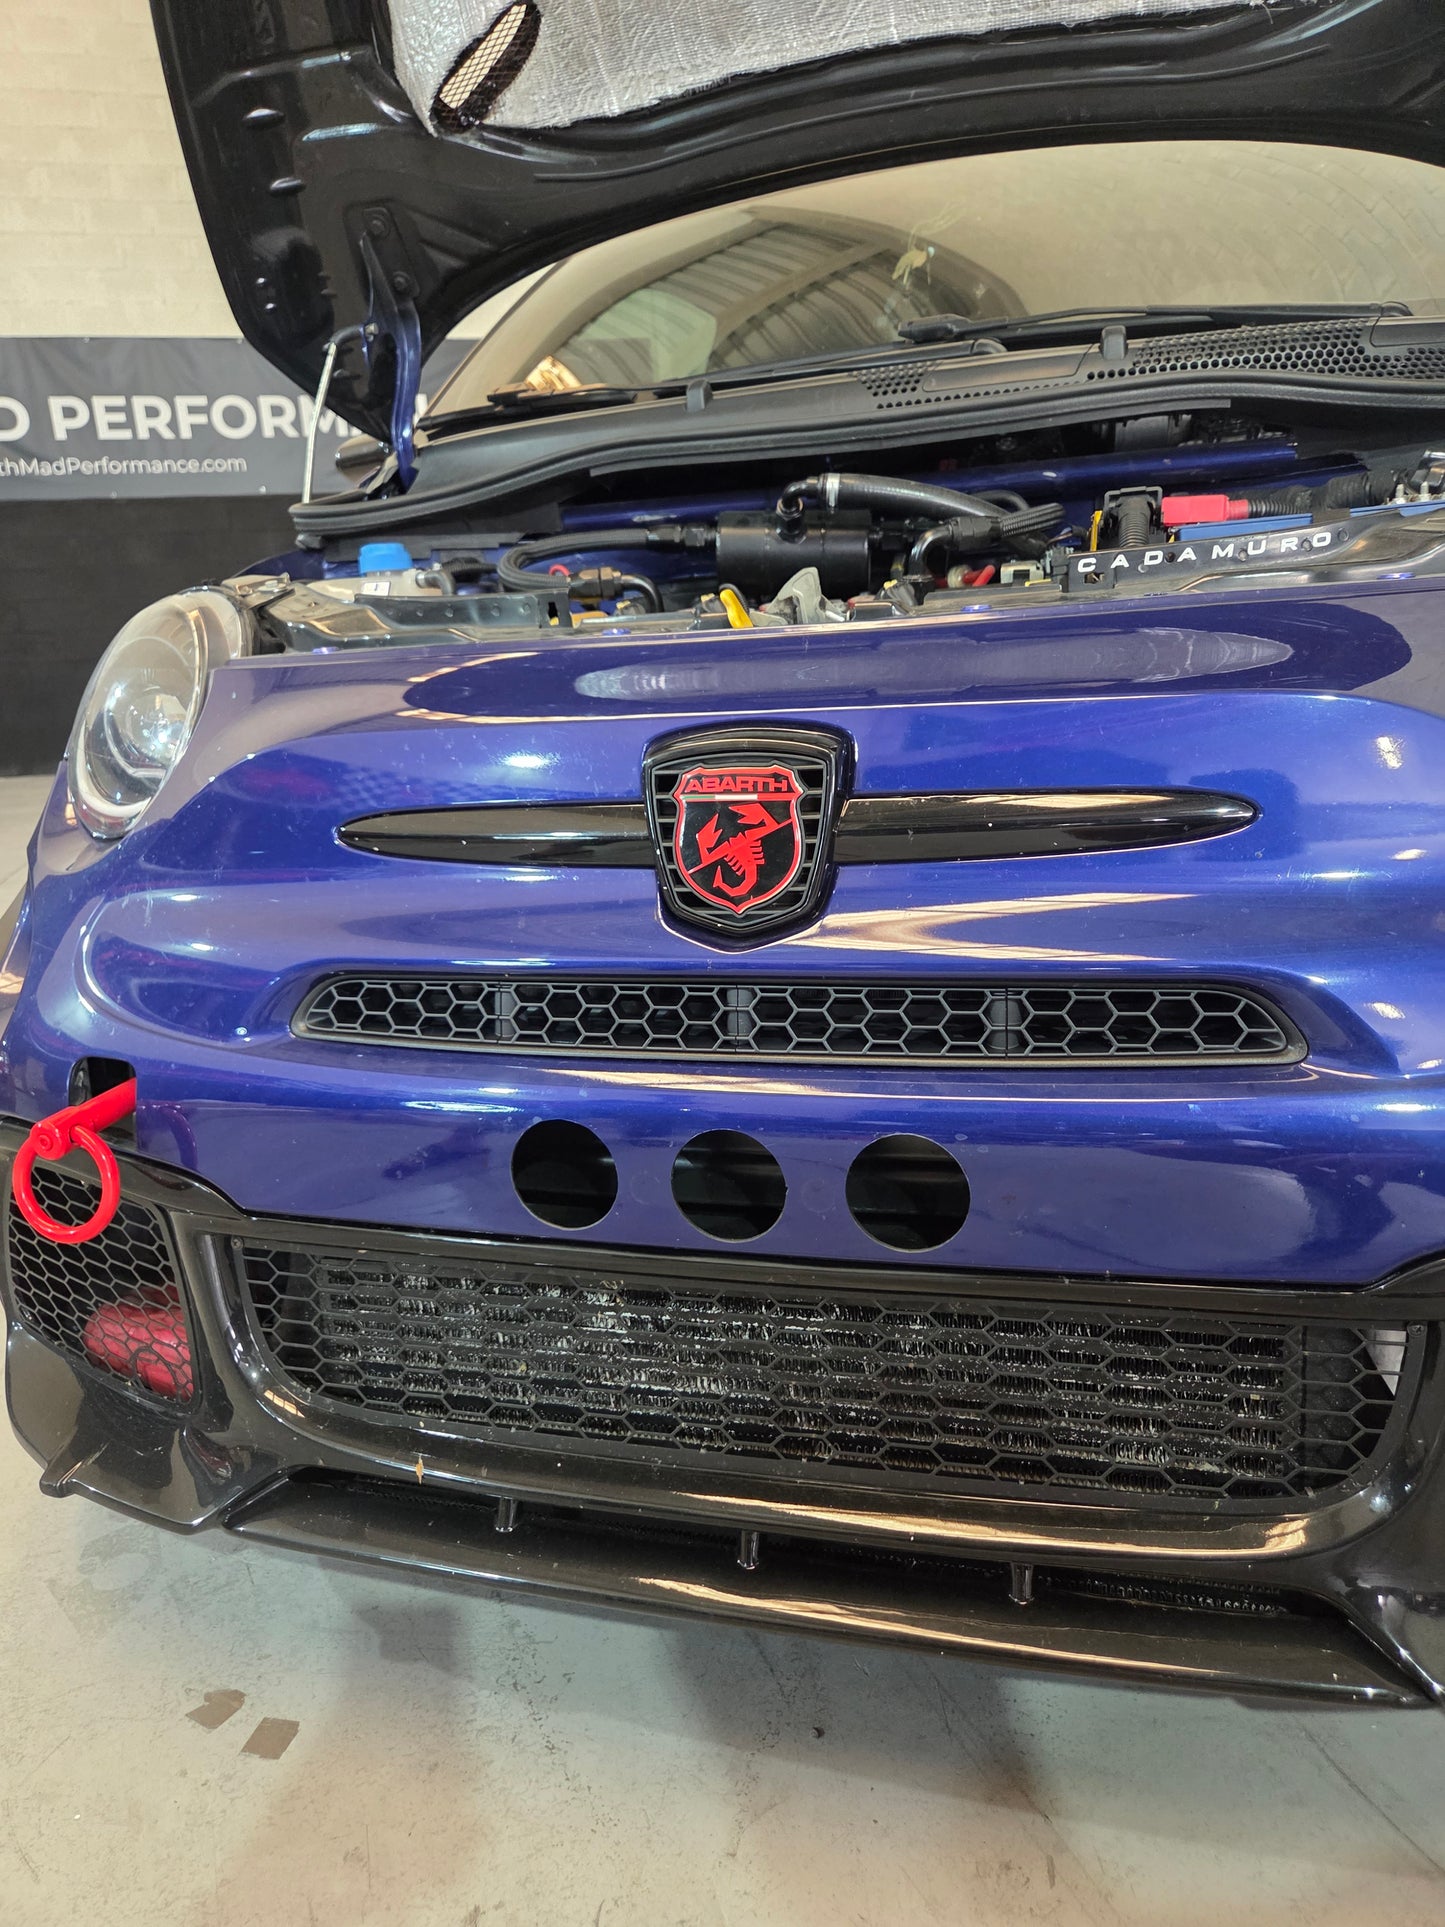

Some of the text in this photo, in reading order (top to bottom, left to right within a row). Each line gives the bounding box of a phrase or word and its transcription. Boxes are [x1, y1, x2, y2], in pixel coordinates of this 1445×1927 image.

[48, 395, 427, 441] PERFORM
[1077, 531, 1332, 573] CADAMURO
[685, 776, 788, 793] ABARTH
